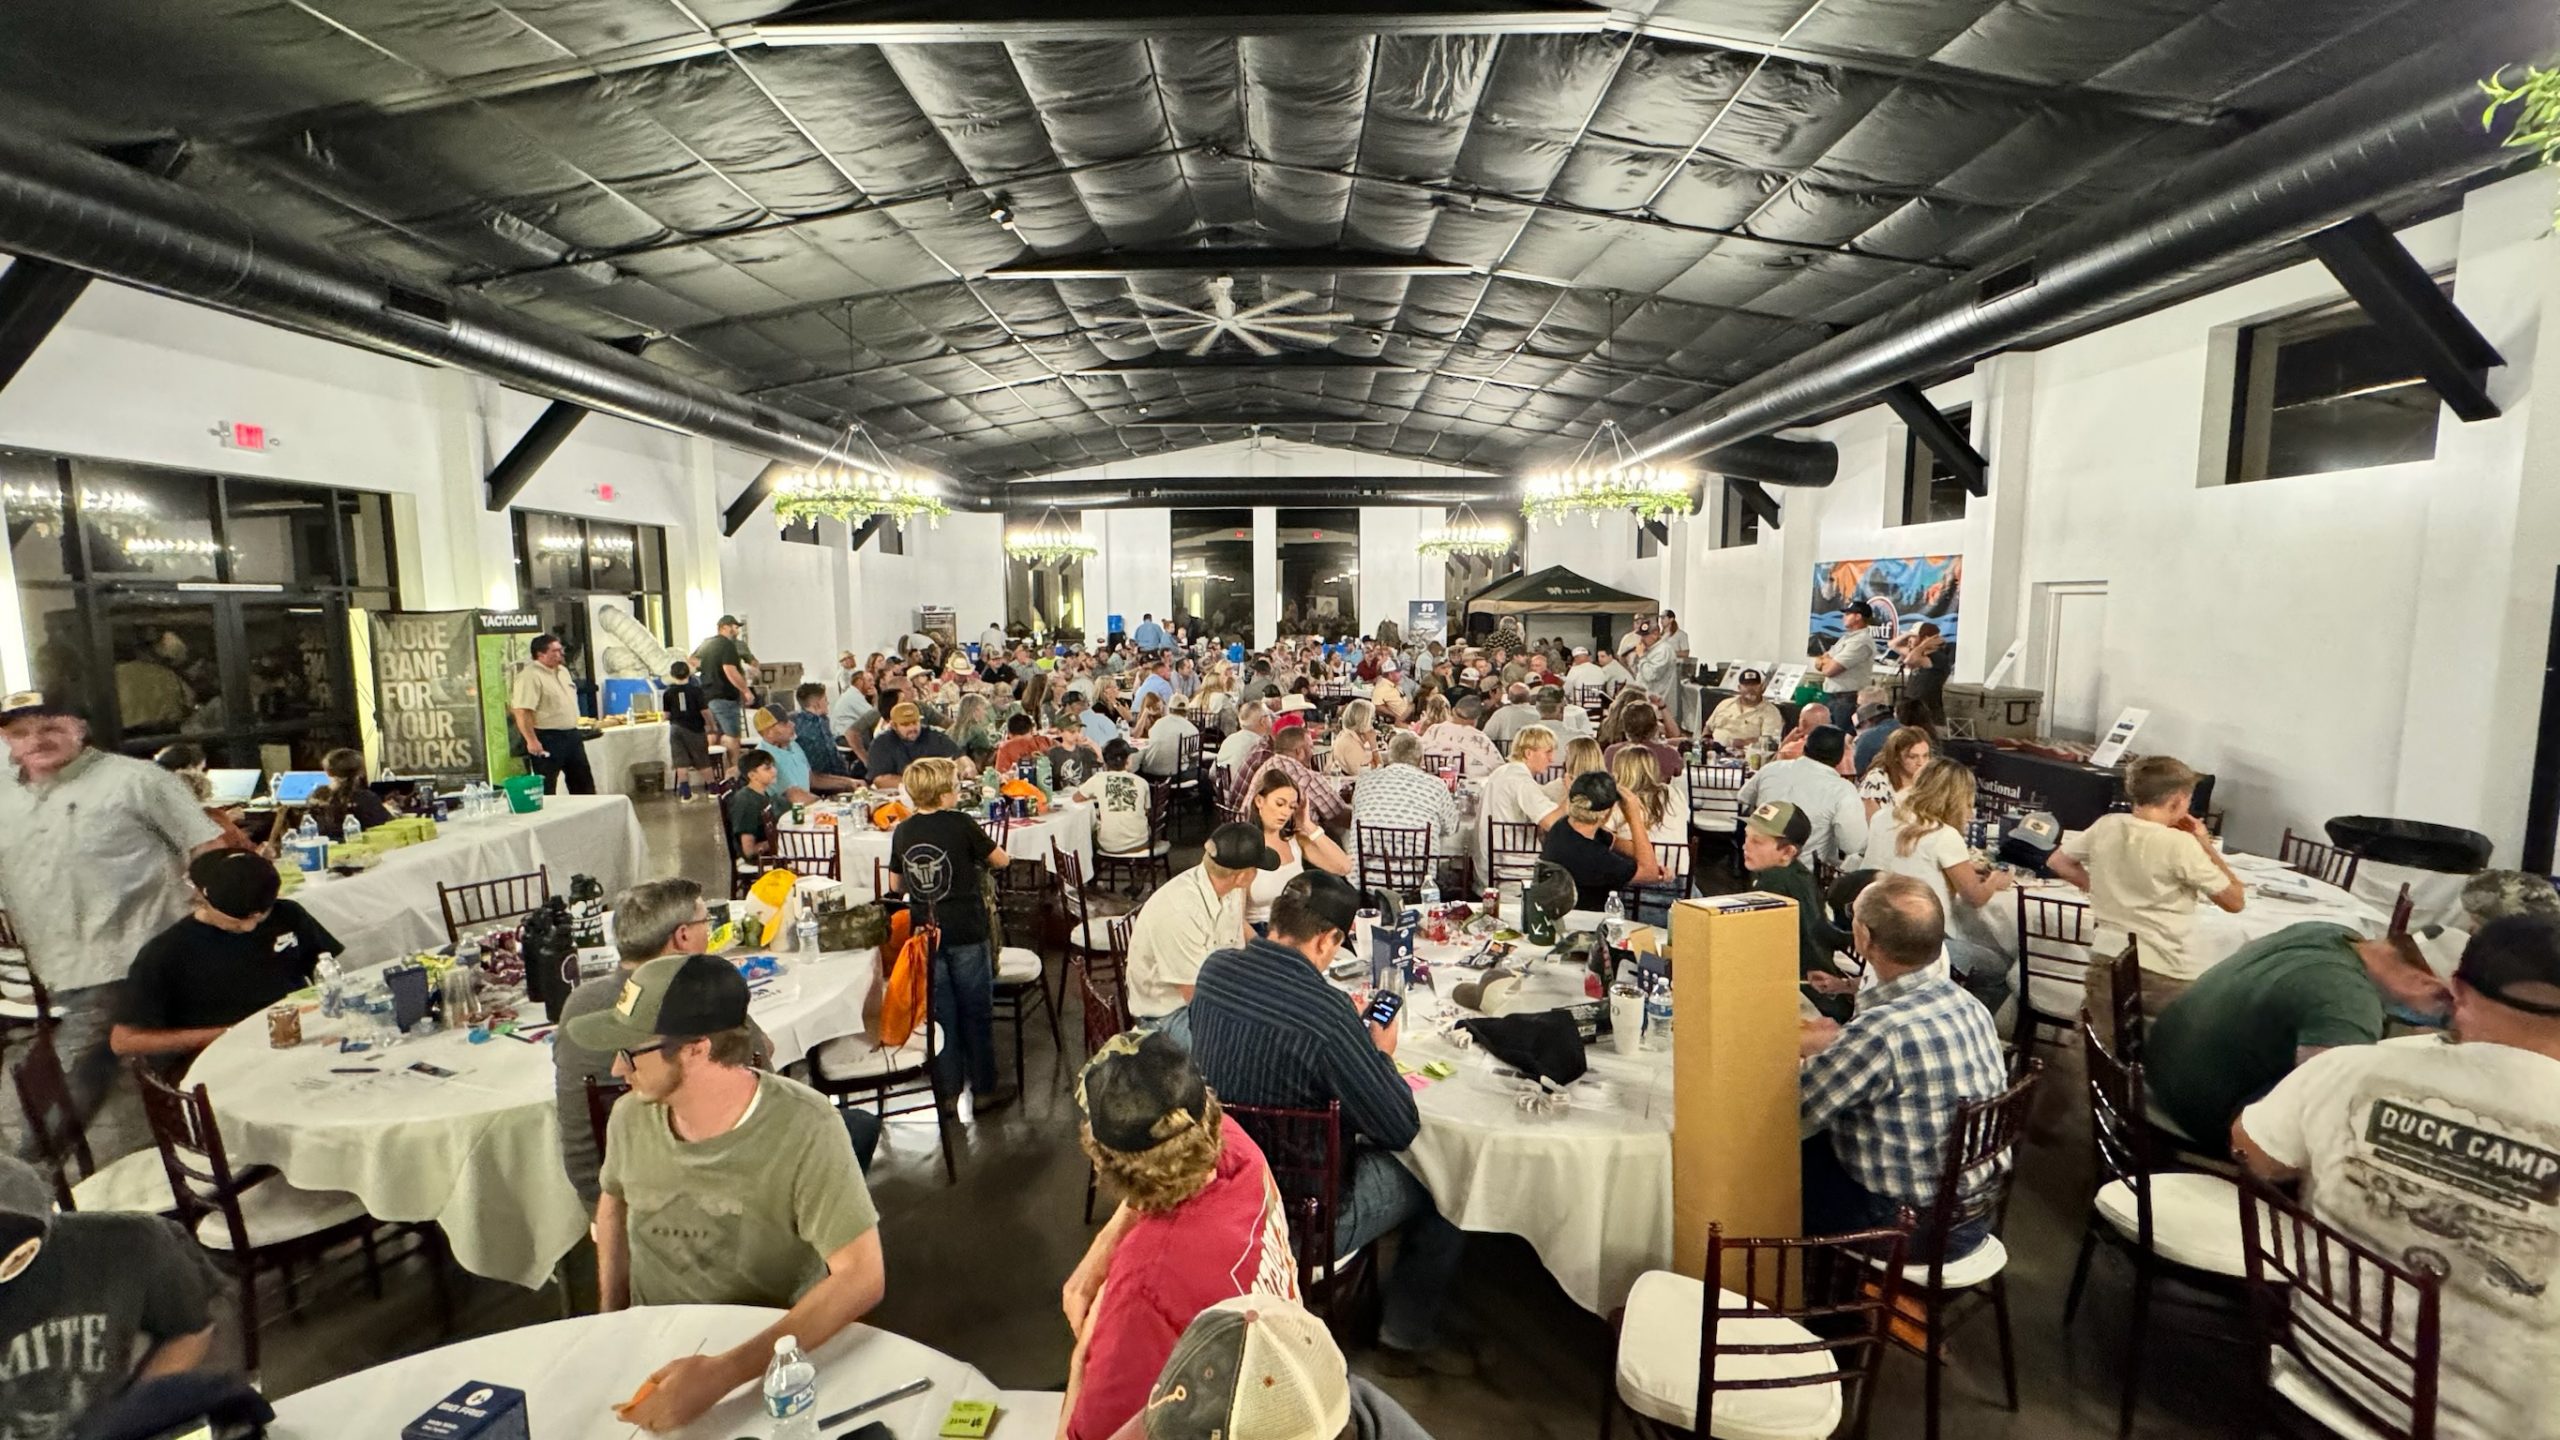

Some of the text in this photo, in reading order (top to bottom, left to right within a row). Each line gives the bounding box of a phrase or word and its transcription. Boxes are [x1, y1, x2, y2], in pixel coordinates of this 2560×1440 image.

[375, 620, 450, 651] MORE
[480, 615, 538, 628] TACTACAM
[379, 650, 448, 680] BANG
[381, 681, 435, 711] FOR
[383, 710, 456, 741] YOUR
[386, 739, 474, 770] BUCKS
[2380, 1107, 2458, 1150] DUCK
[2466, 1136, 2559, 1180] CAMP
